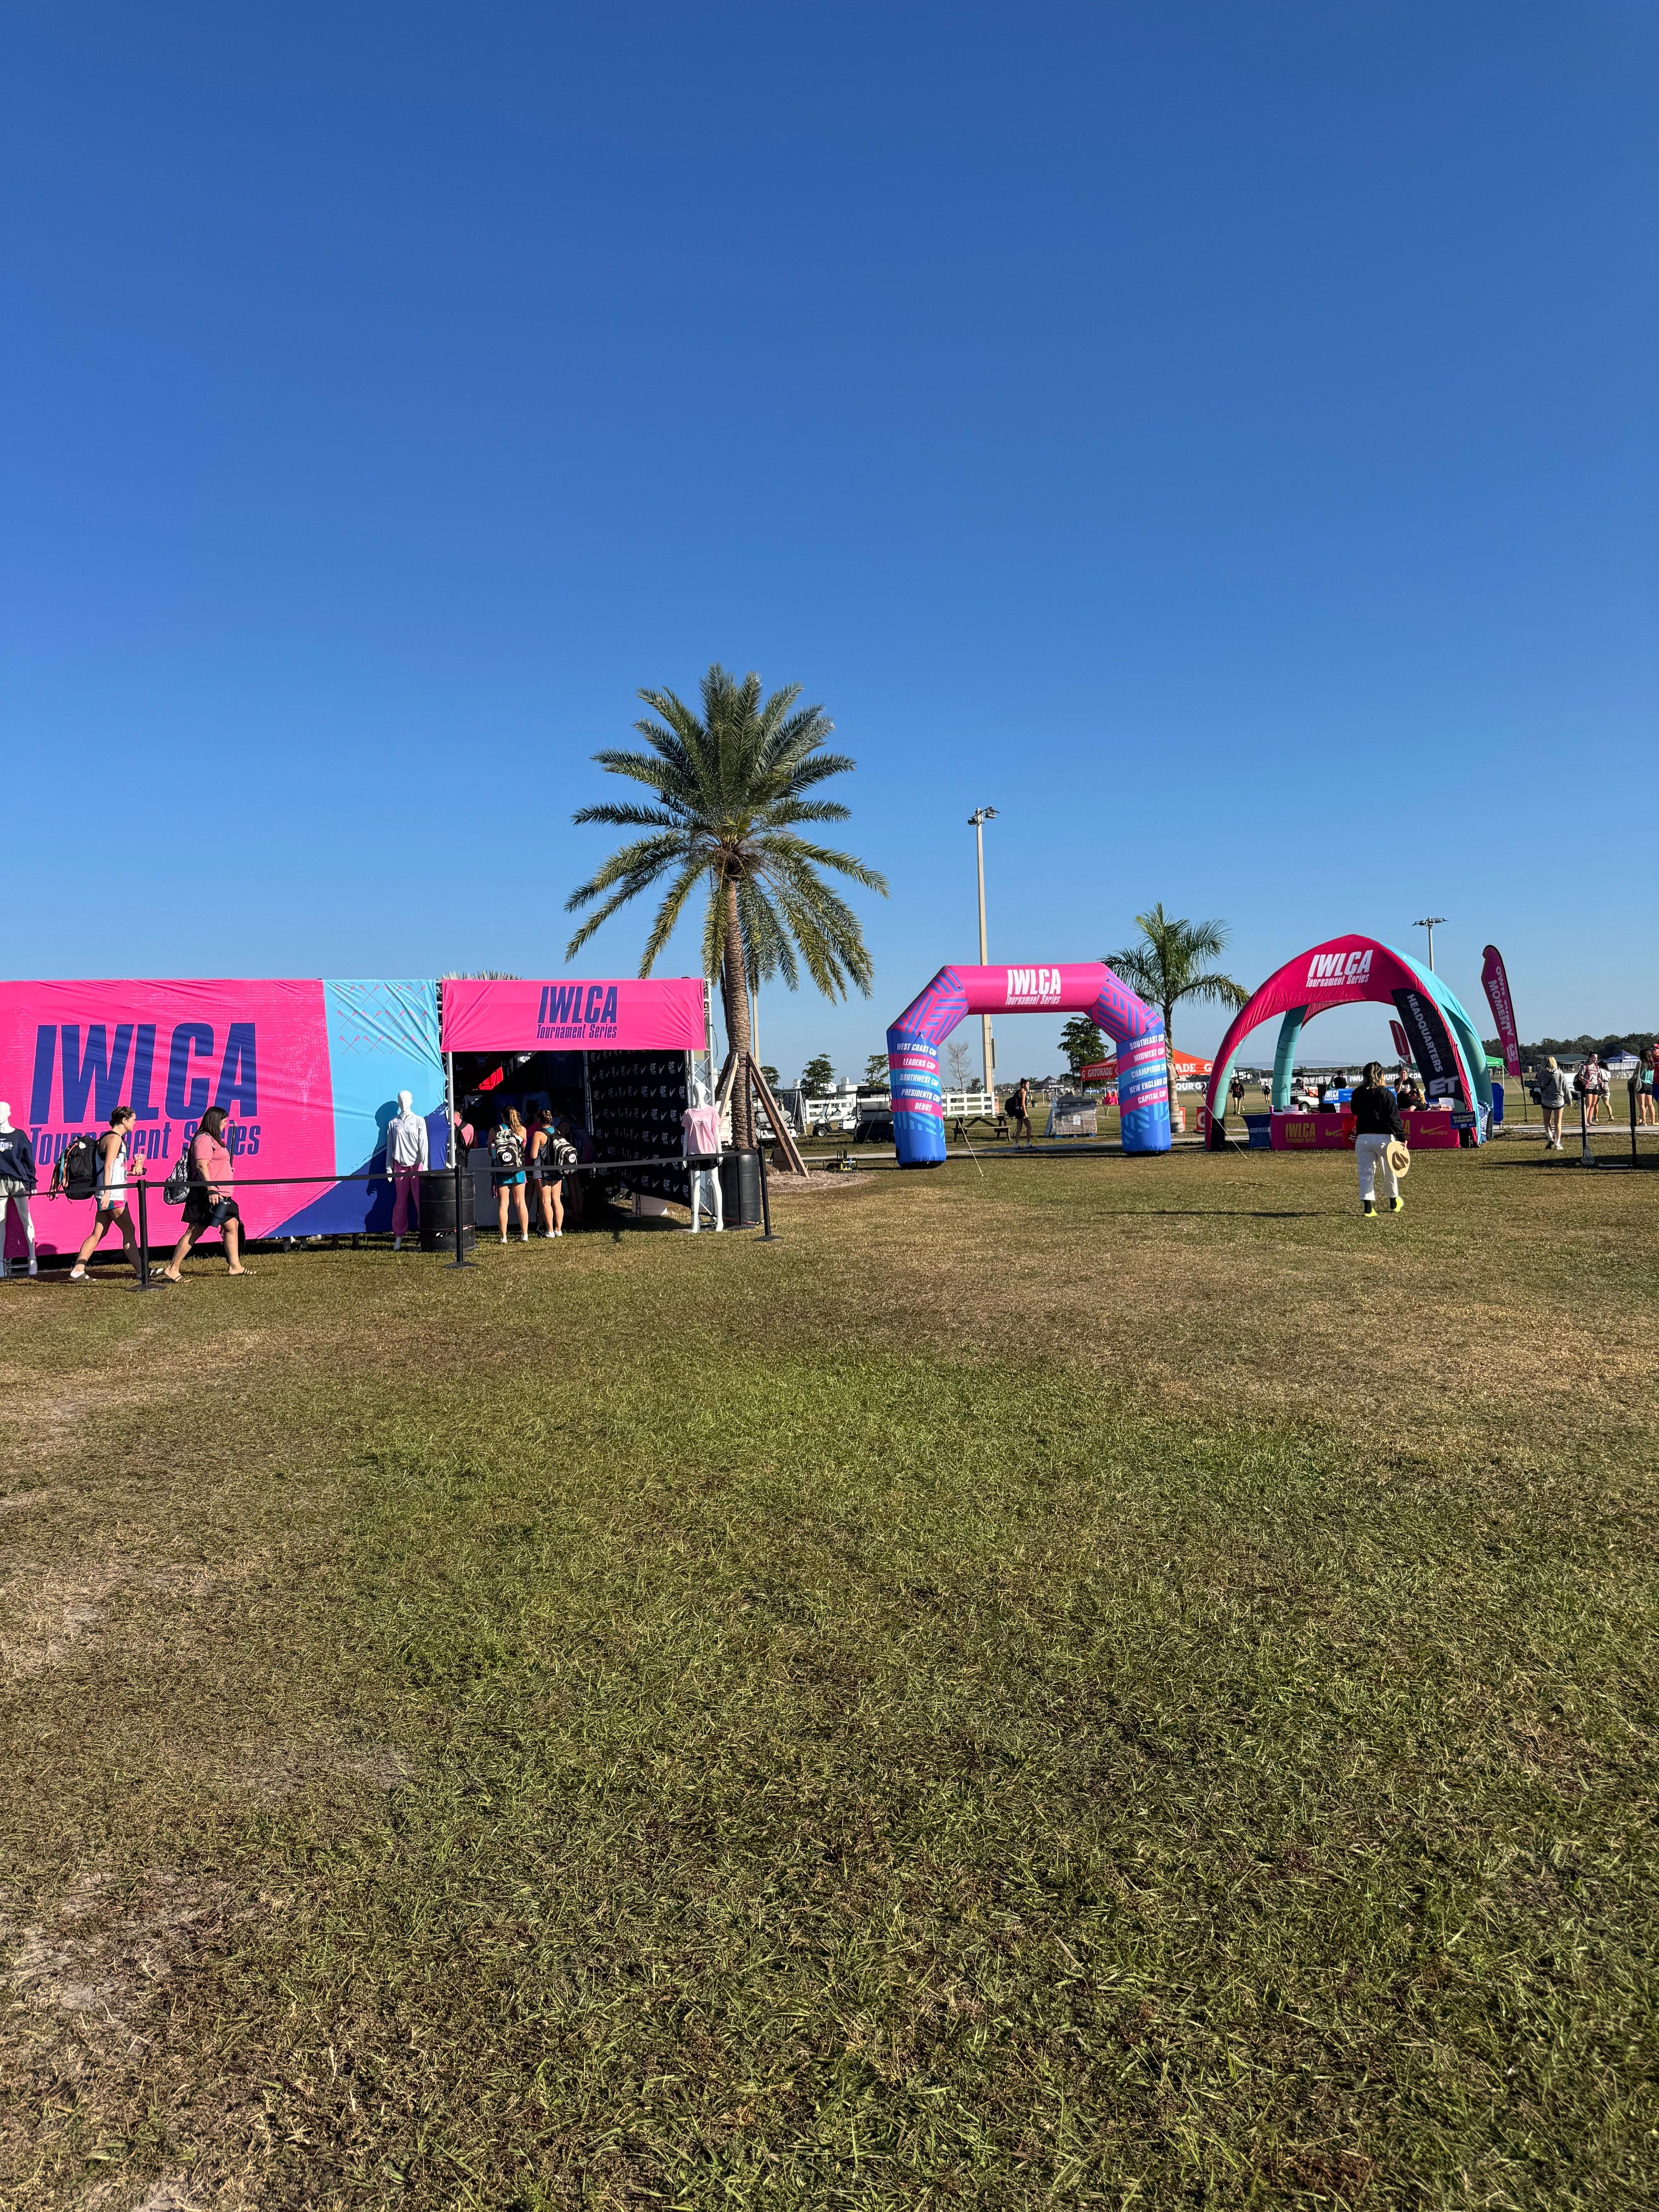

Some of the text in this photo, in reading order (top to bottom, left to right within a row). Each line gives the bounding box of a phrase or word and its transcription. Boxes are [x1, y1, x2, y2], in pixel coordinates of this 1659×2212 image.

[1307, 950, 1373, 977] IWLCA
[1007, 969, 1061, 994] IWLCA
[1305, 973, 1369, 988] Tournament Series
[538, 986, 618, 1024] IWLCA
[1005, 994, 1061, 1005] Tournament Series
[536, 1024, 617, 1039] Tournament Series
[1407, 994, 1443, 1072] HEADQUARTERS
[911, 1043, 929, 1053] COAST
[1130, 1035, 1158, 1050] SOUTHEAST
[1133, 1049, 1157, 1062] MIDWEST
[903, 1058, 926, 1068] LEADERS
[29, 1022, 257, 1125] IWLCA
[1087, 1067, 1113, 1077] GATORADE
[1131, 1064, 1161, 1078] CHAMPIONS
[900, 1073, 931, 1084] SOUTHWEST
[901, 1089, 933, 1100] PRESIDENTS
[1130, 1084, 1140, 1094] NEW
[1138, 1091, 1159, 1104] CAPITAL
[1285, 1122, 1316, 1138] IWLCA
[30, 1120, 261, 1165] Touent Sies
